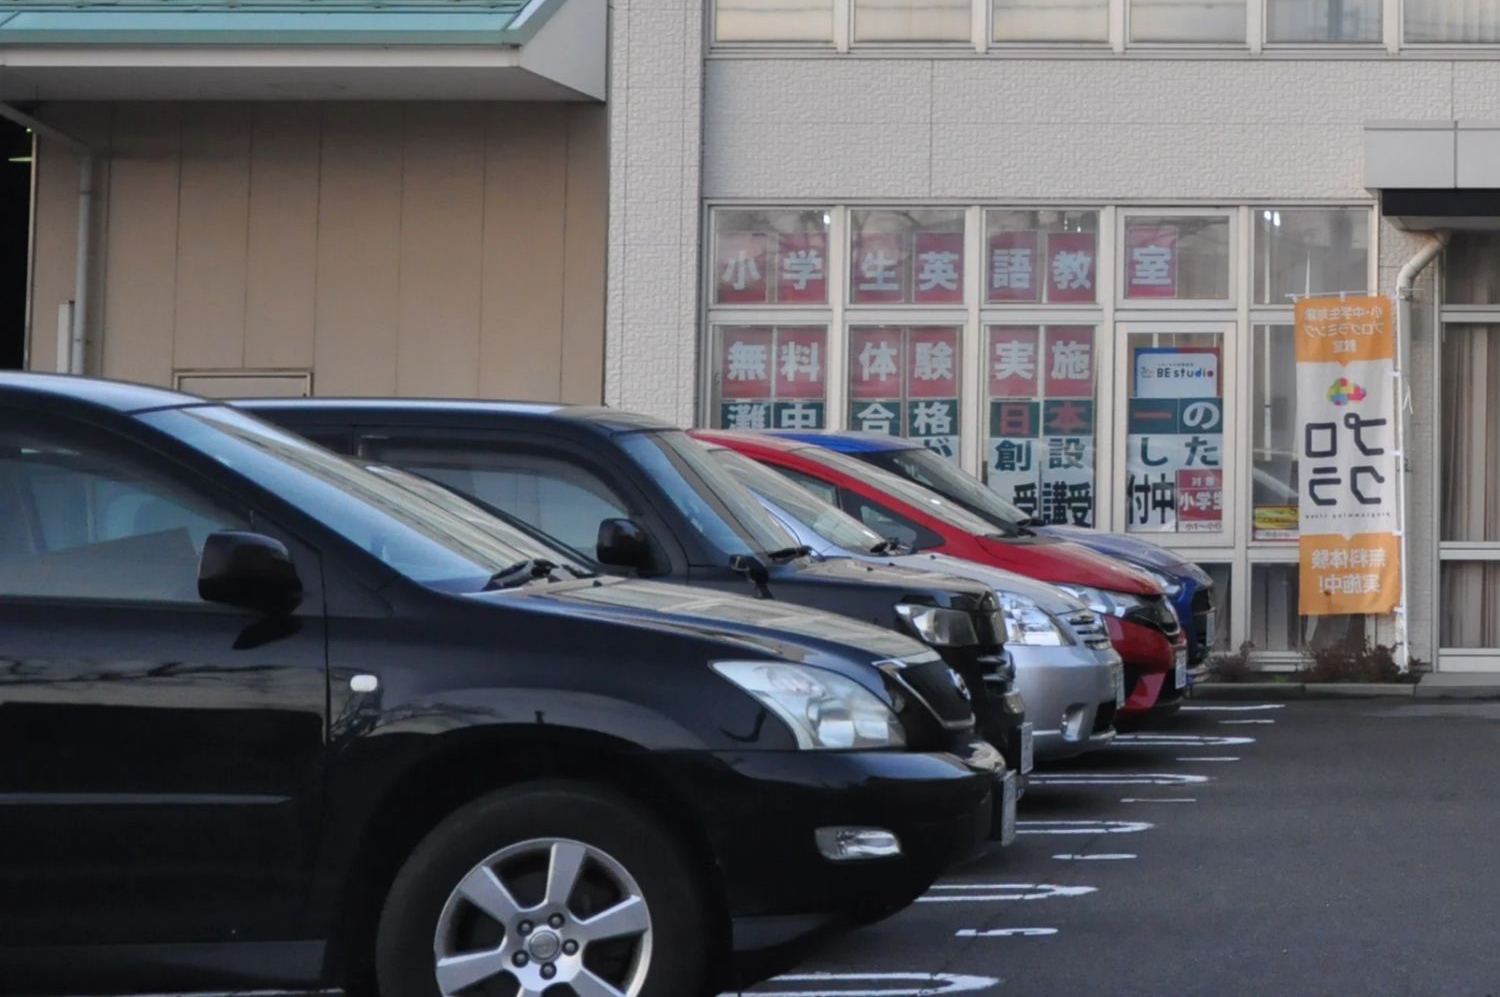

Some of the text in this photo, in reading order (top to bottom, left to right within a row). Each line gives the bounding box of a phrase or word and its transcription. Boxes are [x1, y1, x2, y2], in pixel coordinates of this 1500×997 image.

[722, 246, 1181, 290] 小学生英語教室
[727, 341, 1091, 383] 無料体験実施
[1157, 368, 1171, 378] BE
[1174, 367, 1214, 379] studio
